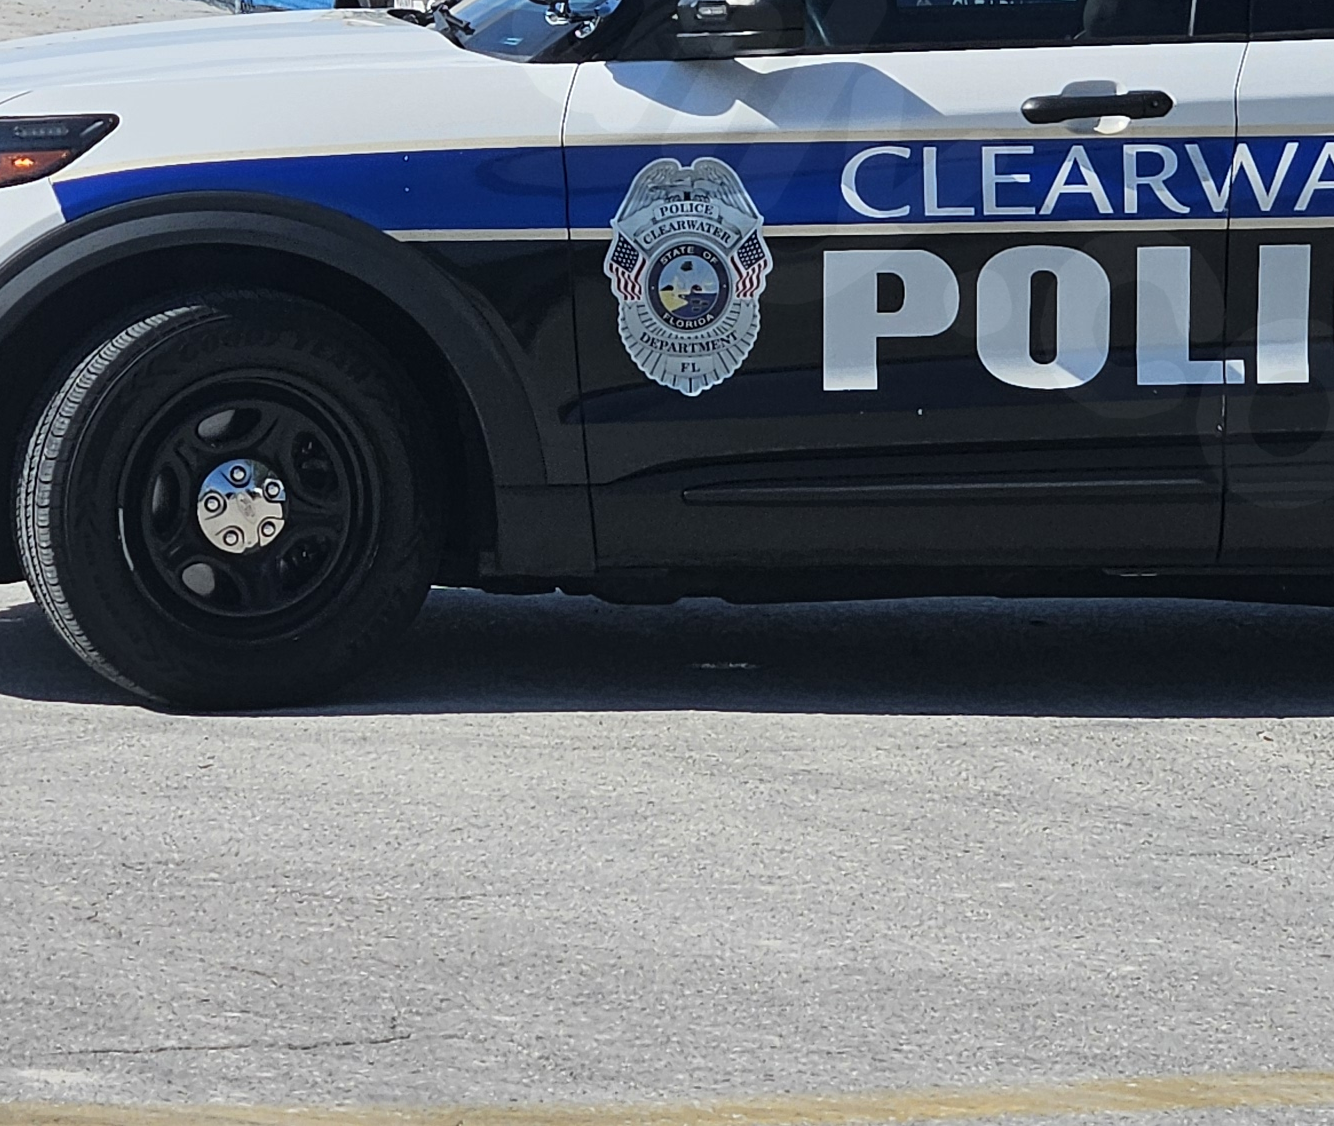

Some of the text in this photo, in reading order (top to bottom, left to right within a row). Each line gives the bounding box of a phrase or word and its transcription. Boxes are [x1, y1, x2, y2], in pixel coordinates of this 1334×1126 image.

[659, 203, 714, 217] POLICE
[642, 219, 732, 245] CLEARWATER
[660, 246, 719, 265] STATE OF
[661, 312, 715, 329] FLORIDA
[639, 331, 739, 354] DEPARTMENT
[680, 362, 701, 373] FL
